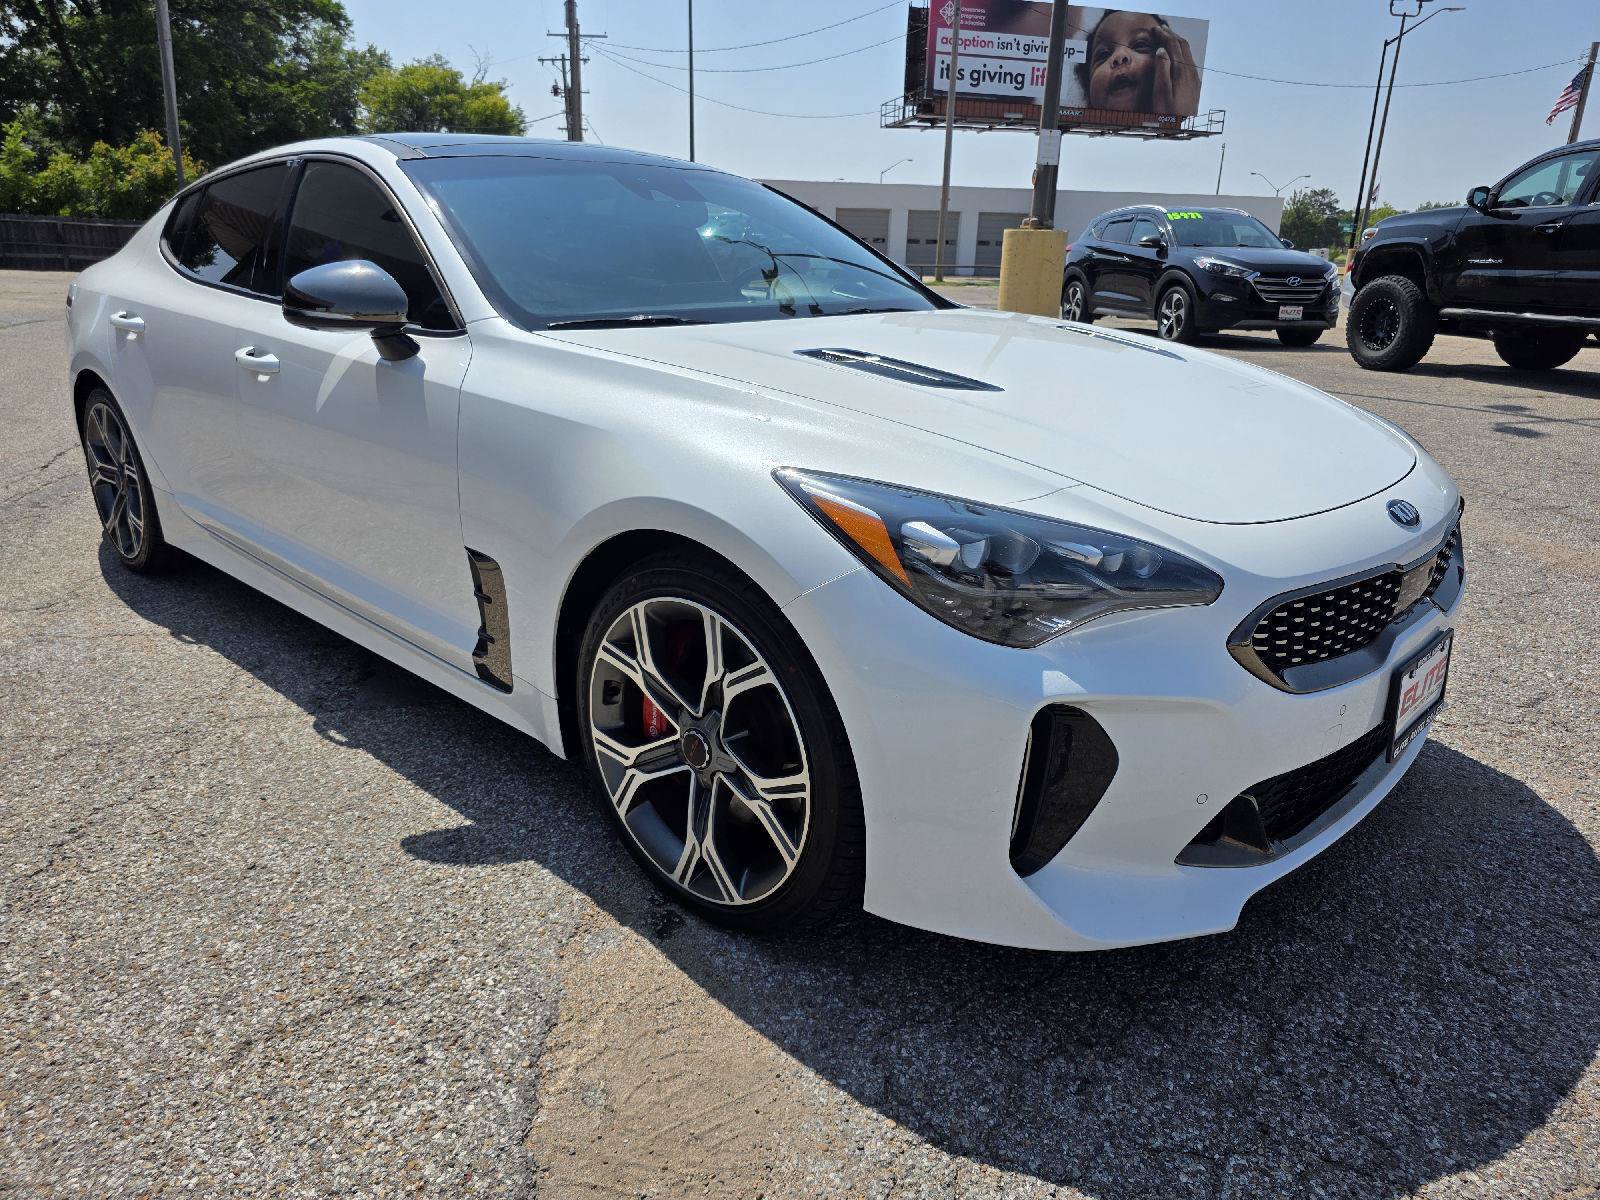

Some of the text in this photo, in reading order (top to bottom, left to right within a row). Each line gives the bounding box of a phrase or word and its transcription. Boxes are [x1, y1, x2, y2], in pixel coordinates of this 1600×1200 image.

[997, 36, 1020, 51] isn't
[969, 64, 1025, 90] giving
[1030, 66, 1046, 86] lif
[1400, 654, 1448, 717] ELITE
